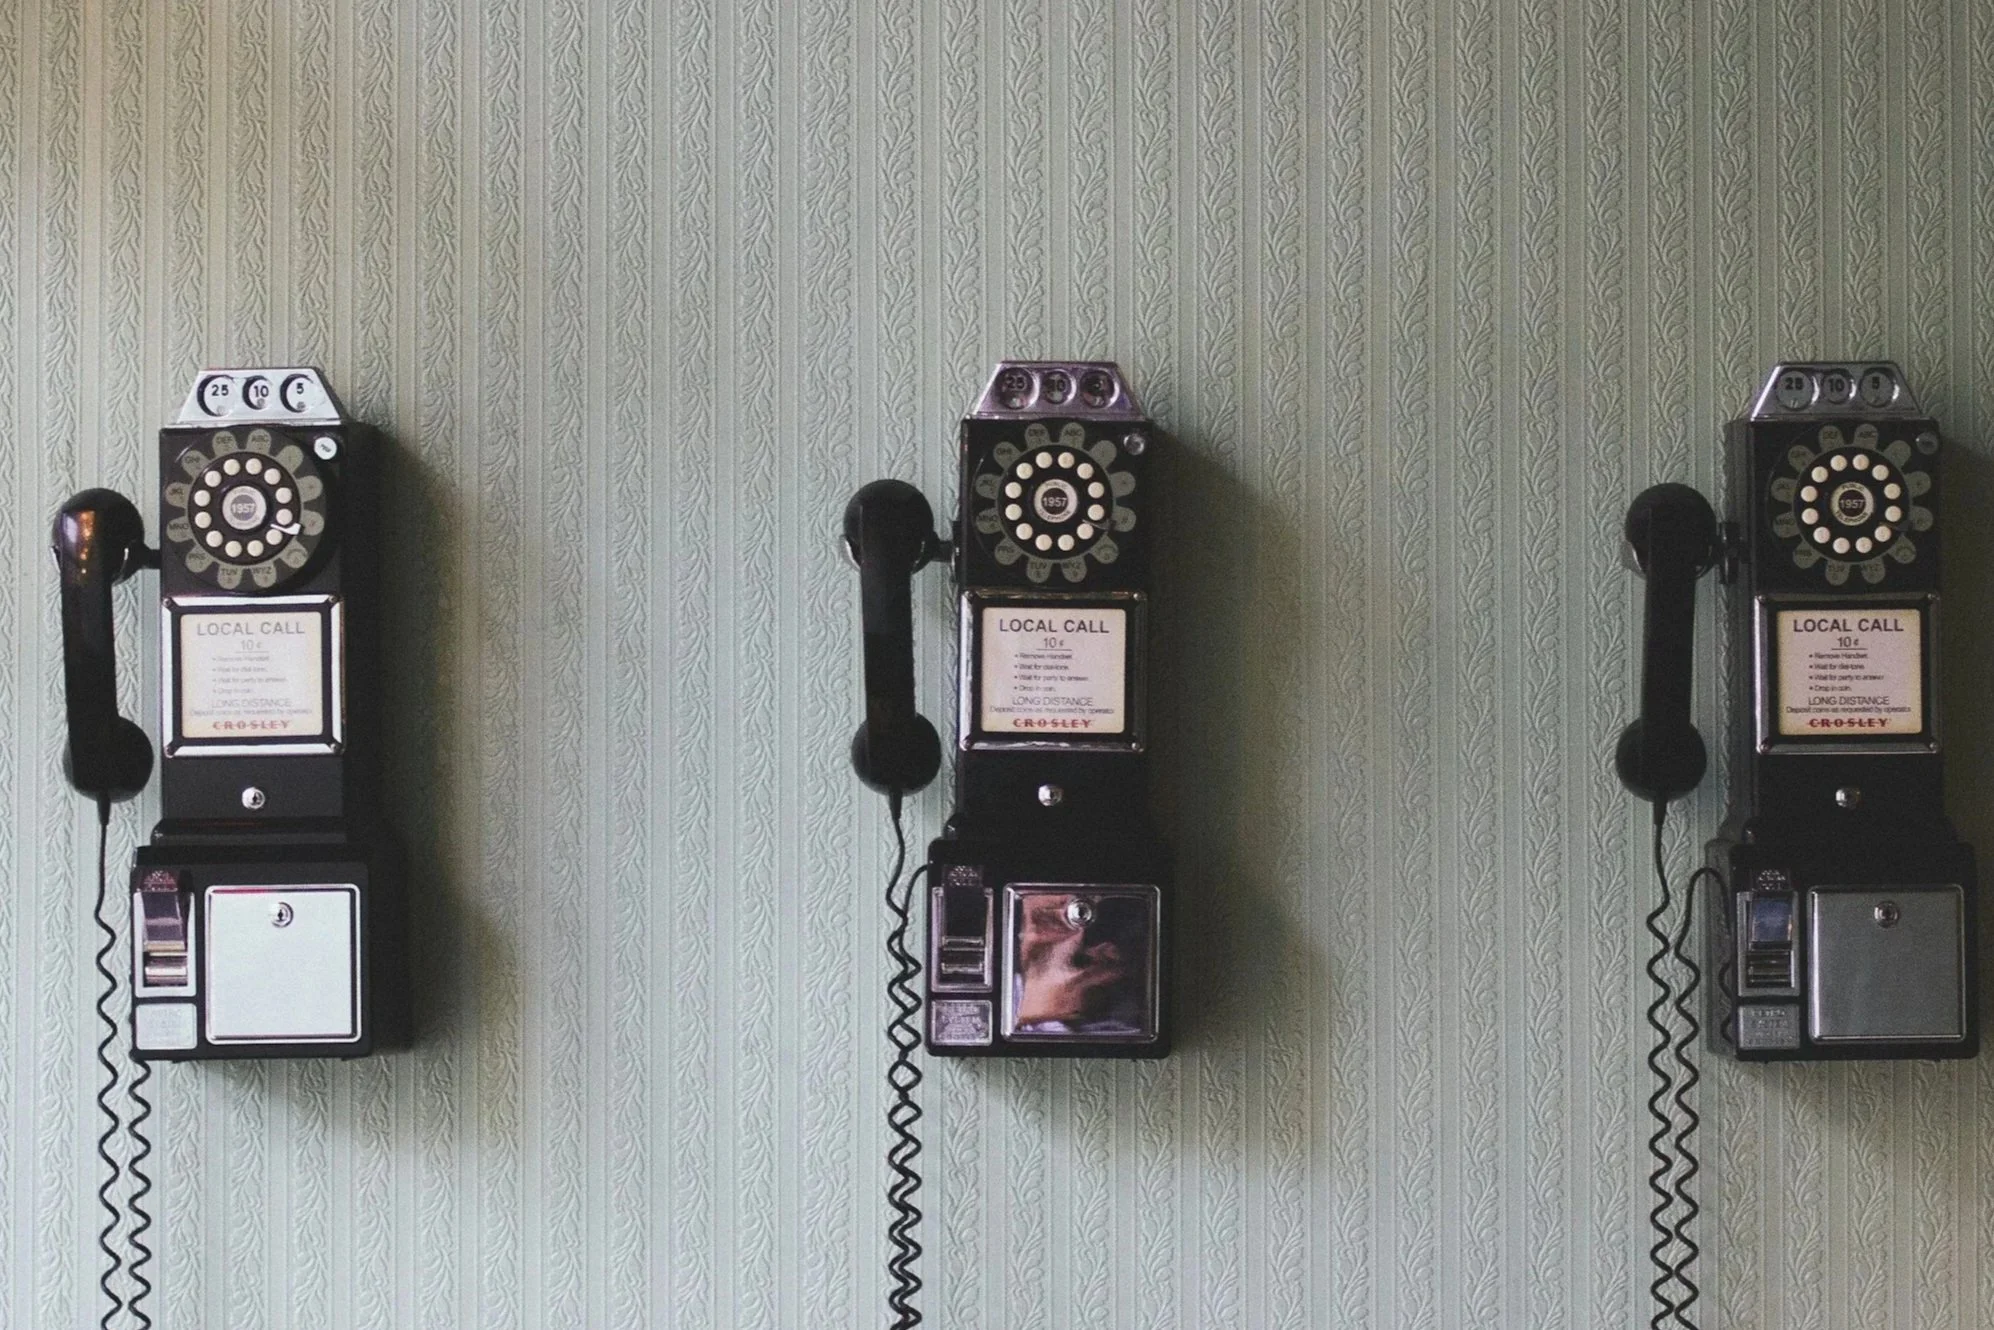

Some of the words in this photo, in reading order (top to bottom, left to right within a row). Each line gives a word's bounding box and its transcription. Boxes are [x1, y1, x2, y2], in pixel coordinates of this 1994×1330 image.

[296, 383, 304, 394] 5
[1785, 377, 1803, 390] 25
[1828, 378, 1844, 392] 10
[211, 384, 229, 396] 25
[253, 385, 269, 397] 10
[1043, 497, 1067, 507] 1957
[1840, 499, 1864, 509] 1957
[231, 503, 255, 514] 1957
[197, 622, 254, 636] LOCAL
[260, 621, 305, 635] CALL
[999, 618, 1057, 632] LOCAL
[1064, 619, 1110, 634] CALL
[1793, 618, 1852, 632] LOCAL
[1858, 618, 1904, 632] CALL
[1012, 696, 1041, 705] LONG
[1043, 696, 1093, 706] DISTANCE
[1808, 696, 1837, 705] LONG
[1839, 696, 1890, 705] DISTANCE
[212, 720, 290, 730] CROSLEY
[1012, 718, 1092, 728] CROSLEY
[1808, 718, 1888, 728] CROSLEY
